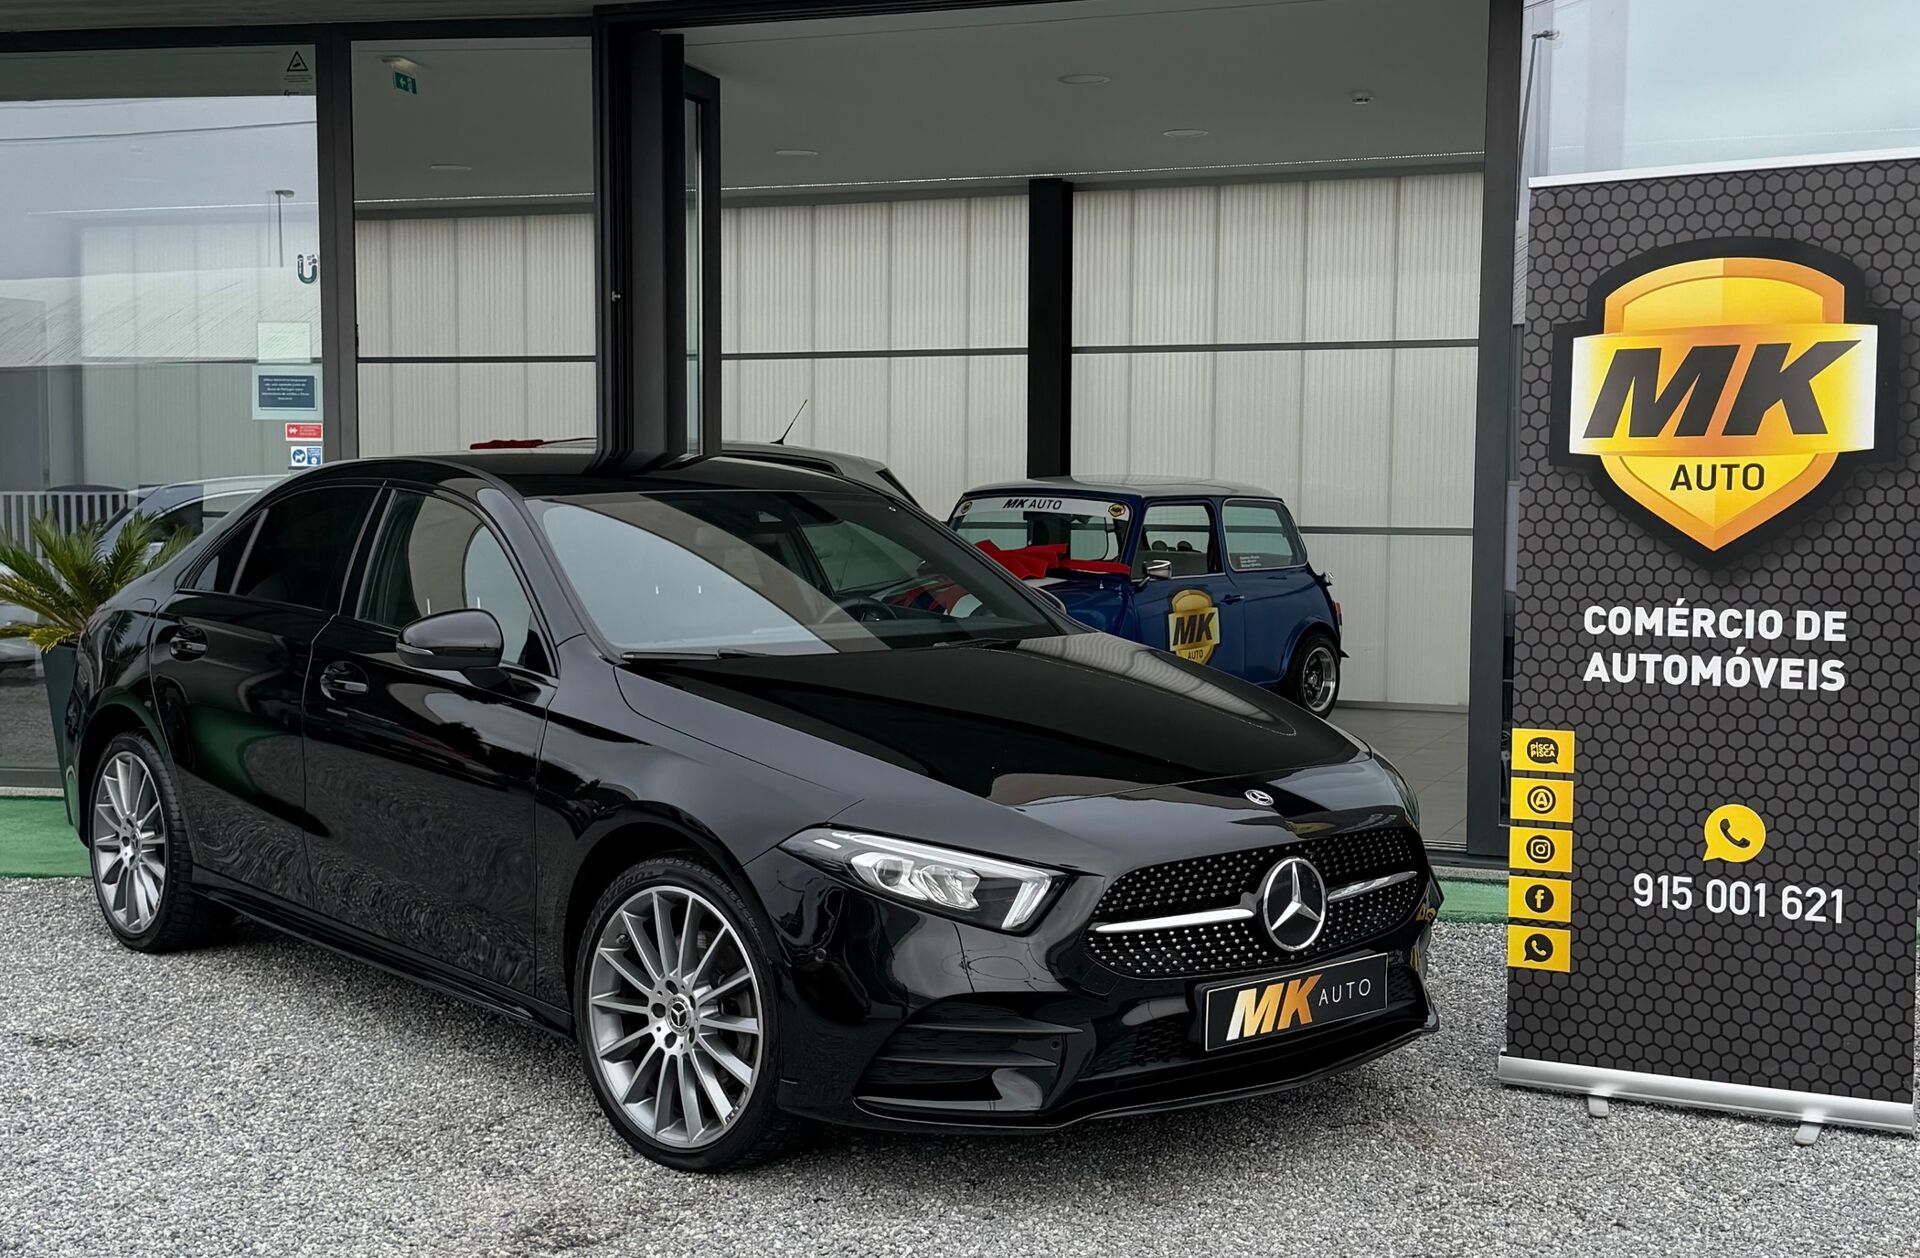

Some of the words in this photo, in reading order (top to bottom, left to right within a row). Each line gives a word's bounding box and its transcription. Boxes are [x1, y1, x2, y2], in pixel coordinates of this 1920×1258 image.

[1583, 339, 1862, 439] MK
[1670, 462, 1765, 492] AUTO
[1002, 498, 1029, 509] MK
[1028, 499, 1062, 510] AUTO
[1173, 612, 1216, 646] MK
[1584, 598, 1783, 640] COMÉRCIO
[1796, 610, 1847, 642] DE
[1187, 649, 1204, 660] AUTO
[1583, 646, 1846, 692] AUTOMÓVEIS
[1530, 742, 1555, 751] PISCA
[1530, 750, 1555, 758] PISCA
[1633, 873, 1693, 911] 915
[1705, 879, 1766, 917] 001
[1781, 885, 1844, 924] 621
[1226, 974, 1322, 1041] MK
[1318, 978, 1371, 1007] AUTO
